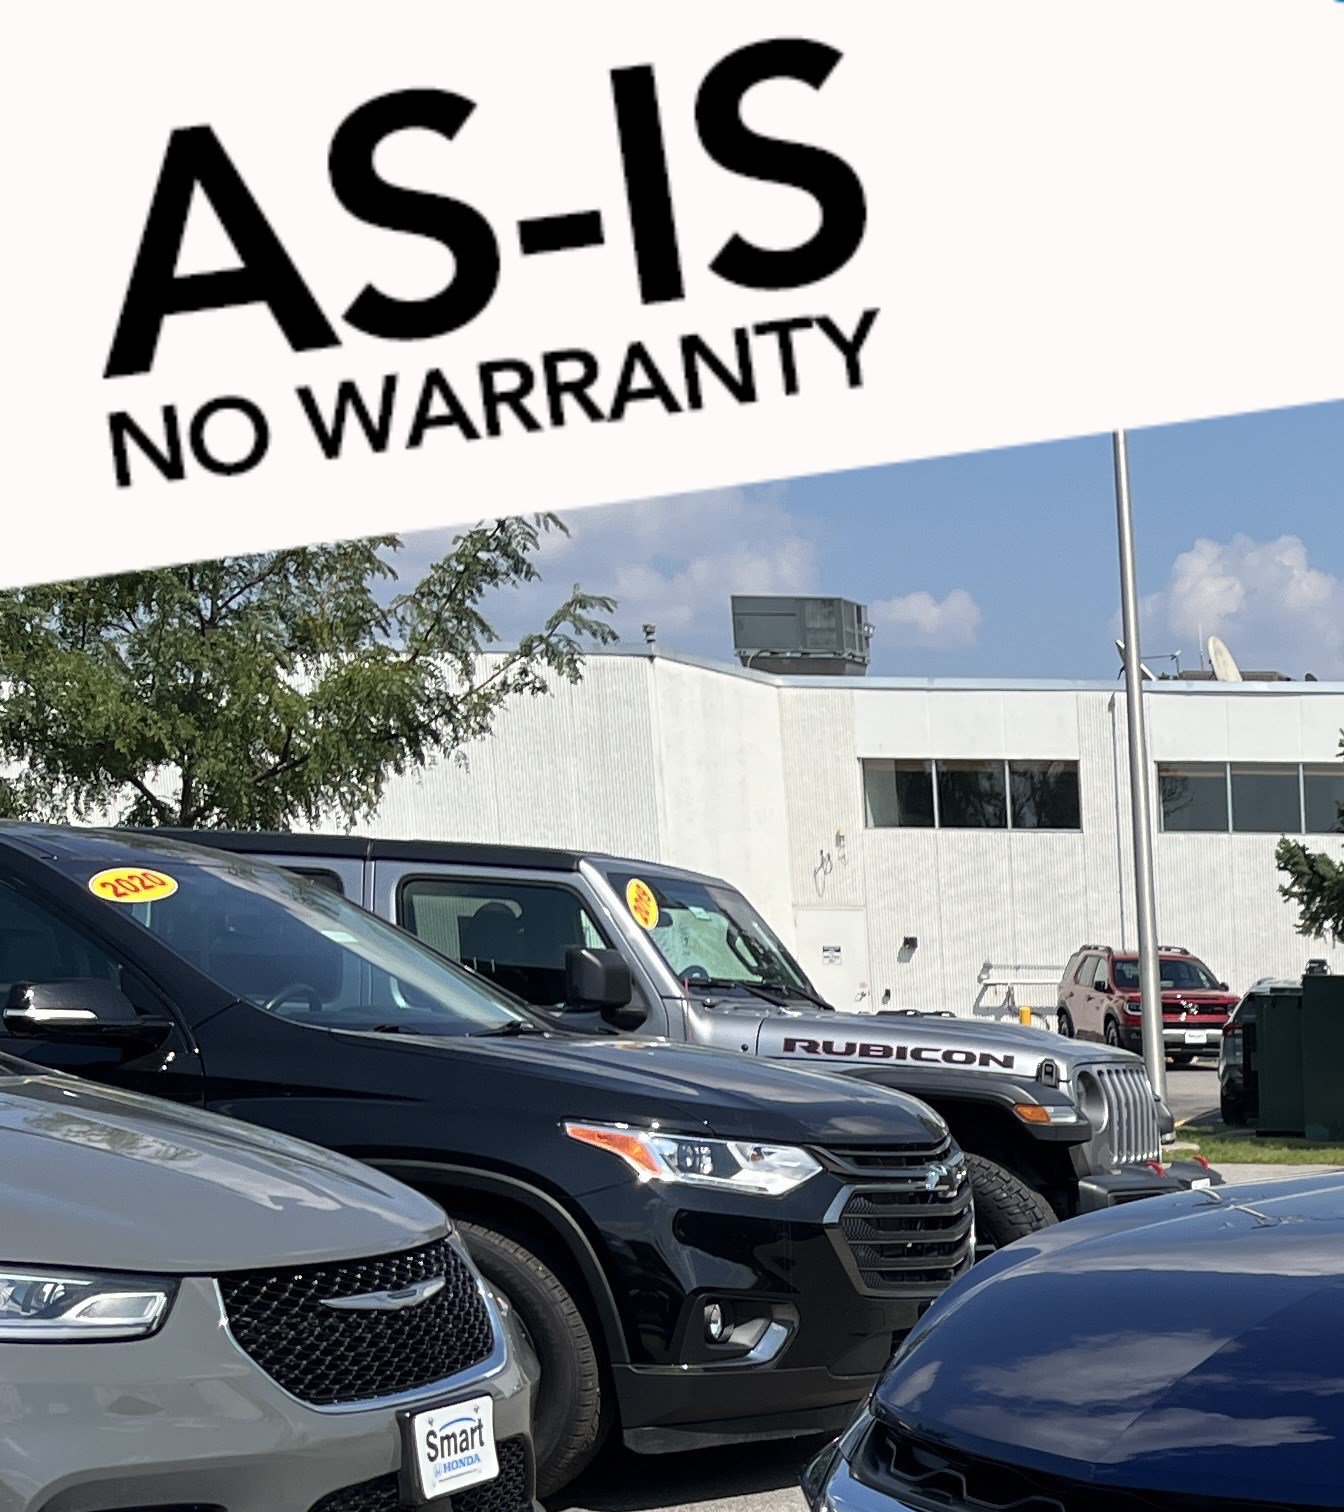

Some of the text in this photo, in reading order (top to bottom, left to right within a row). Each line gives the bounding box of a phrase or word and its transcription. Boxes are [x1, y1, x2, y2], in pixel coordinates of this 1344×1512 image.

[100, 872, 168, 899] 2020
[783, 1037, 1015, 1070] RUBICON
[426, 1418, 485, 1462] Smart
[443, 1453, 481, 1473] HONDA
